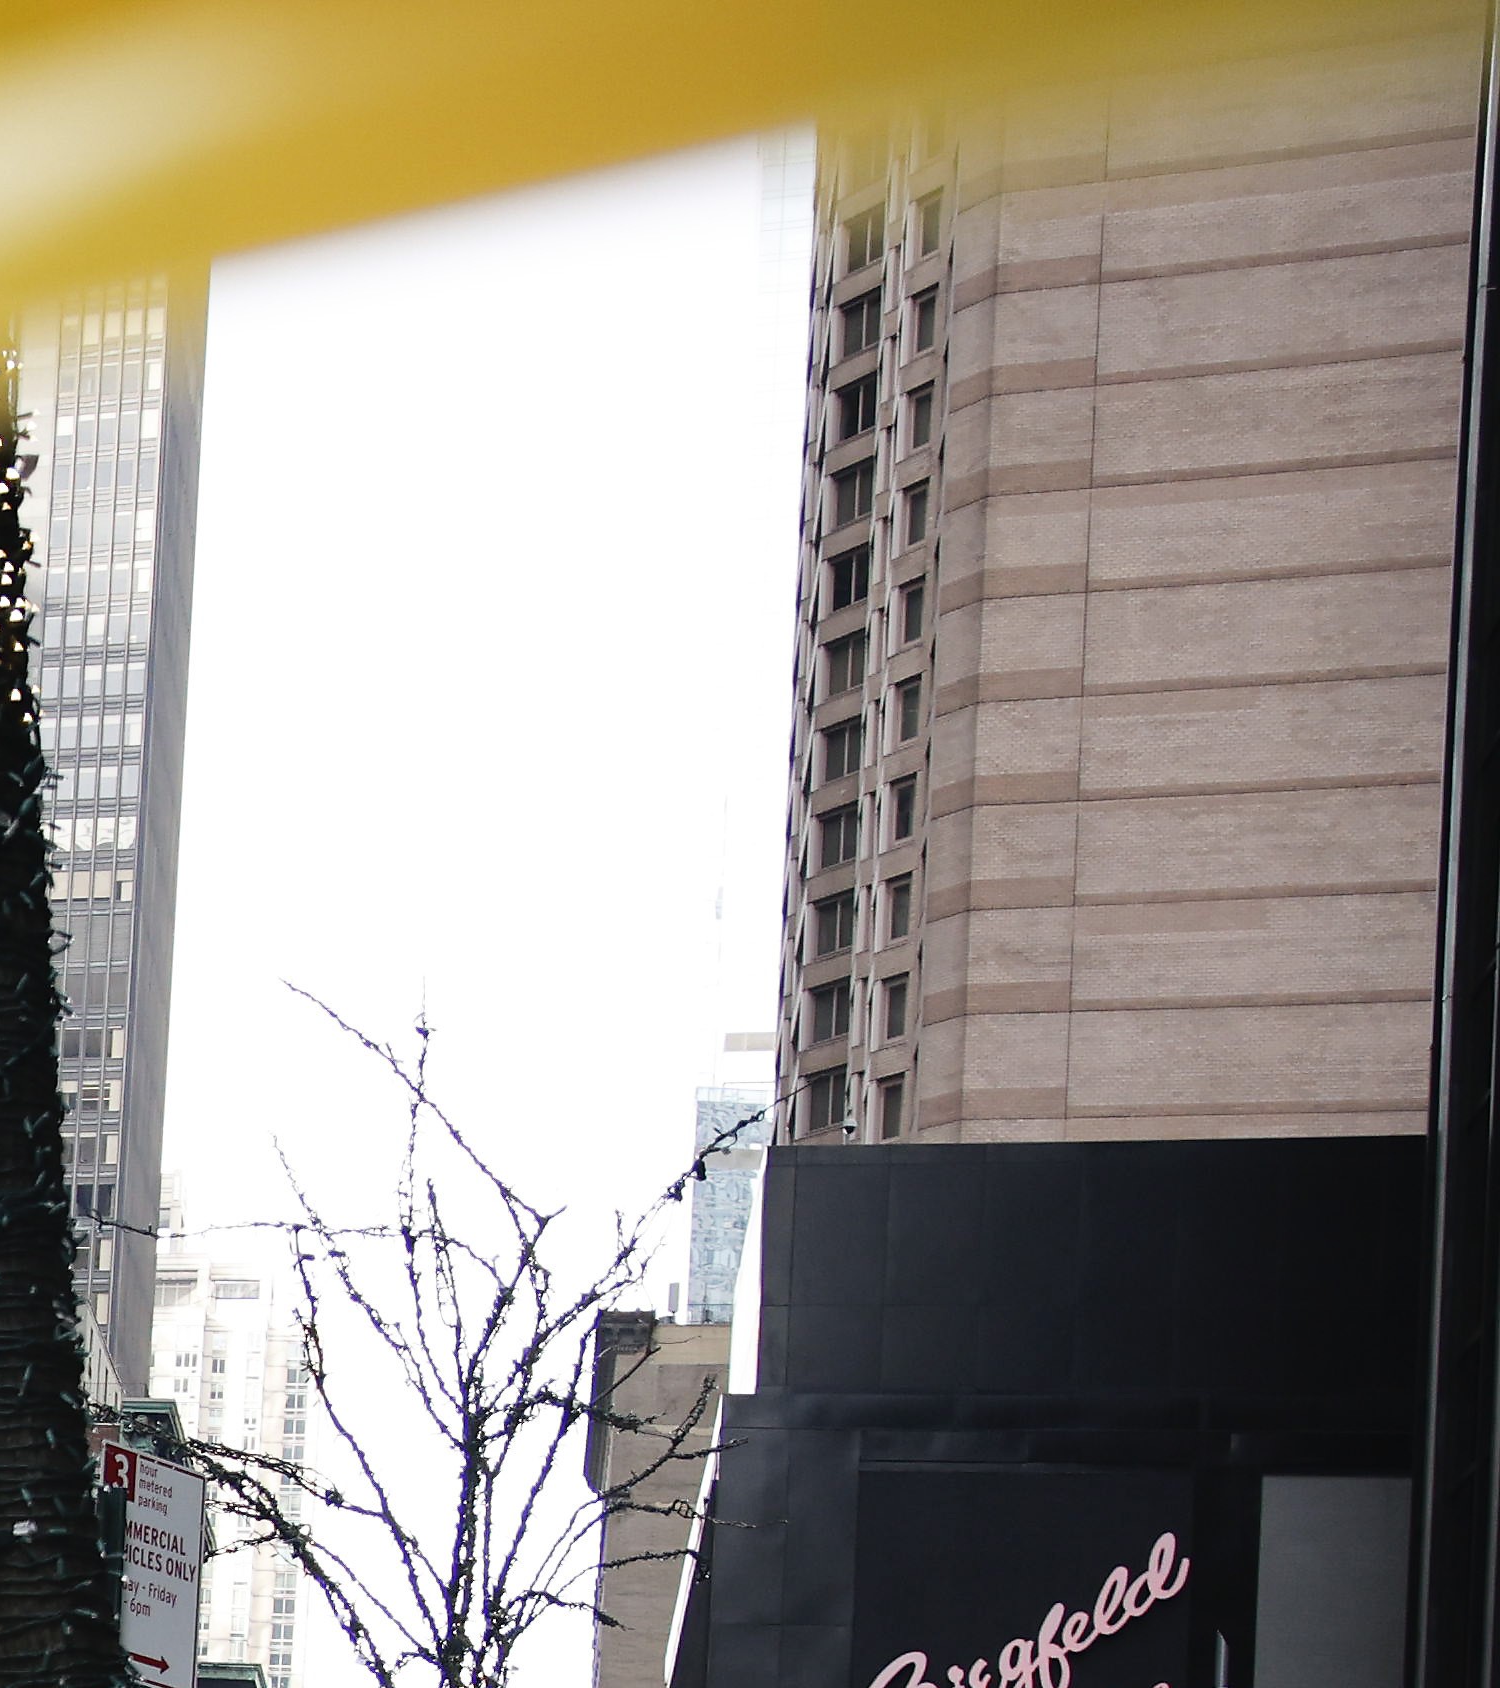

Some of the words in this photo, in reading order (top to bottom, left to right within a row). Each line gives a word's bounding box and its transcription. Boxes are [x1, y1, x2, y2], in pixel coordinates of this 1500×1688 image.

[115, 1454, 129, 1488] 3
[140, 1461, 158, 1478] hour
[139, 1479, 173, 1498] metered
[138, 1496, 168, 1516] parking
[125, 1521, 186, 1556] MMERCIAL
[166, 1558, 197, 1583] ONLY
[148, 1583, 177, 1608] Friday
[130, 1598, 151, 1616] 6pm
